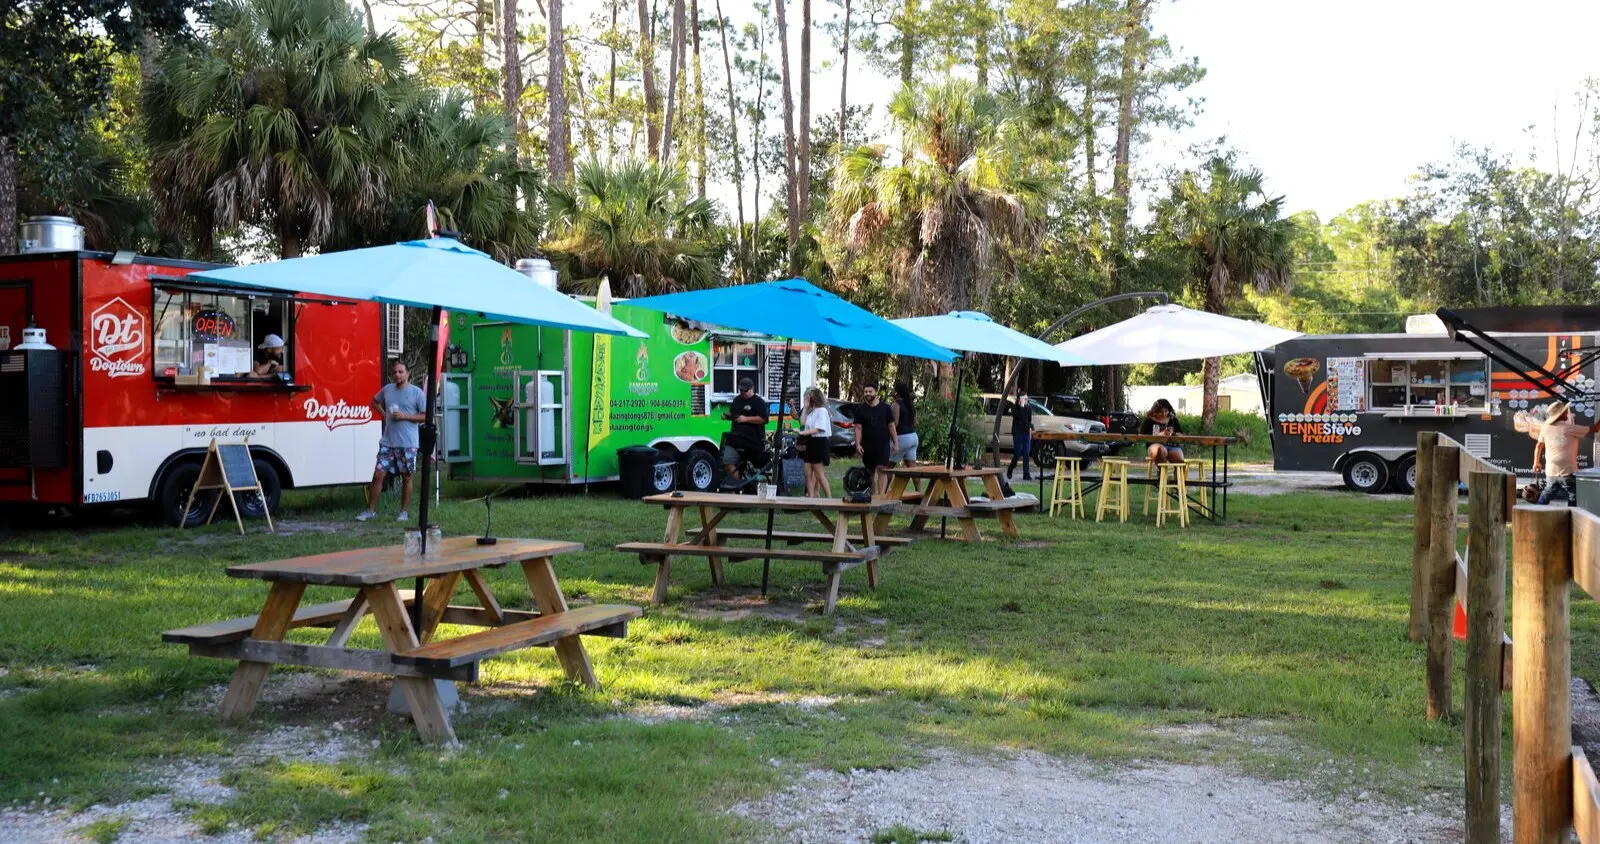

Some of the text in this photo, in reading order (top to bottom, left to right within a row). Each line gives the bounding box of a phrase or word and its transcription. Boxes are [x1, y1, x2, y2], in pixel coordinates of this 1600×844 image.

[94, 313, 141, 350] Dt
[196, 317, 233, 337] OPEN
[90, 358, 145, 378] Dogtown
[609, 399, 646, 408] 04-217-2920
[303, 397, 372, 431] Dogtown
[210, 427, 228, 437] bad
[232, 426, 257, 438] days
[1303, 433, 1344, 443] treats
